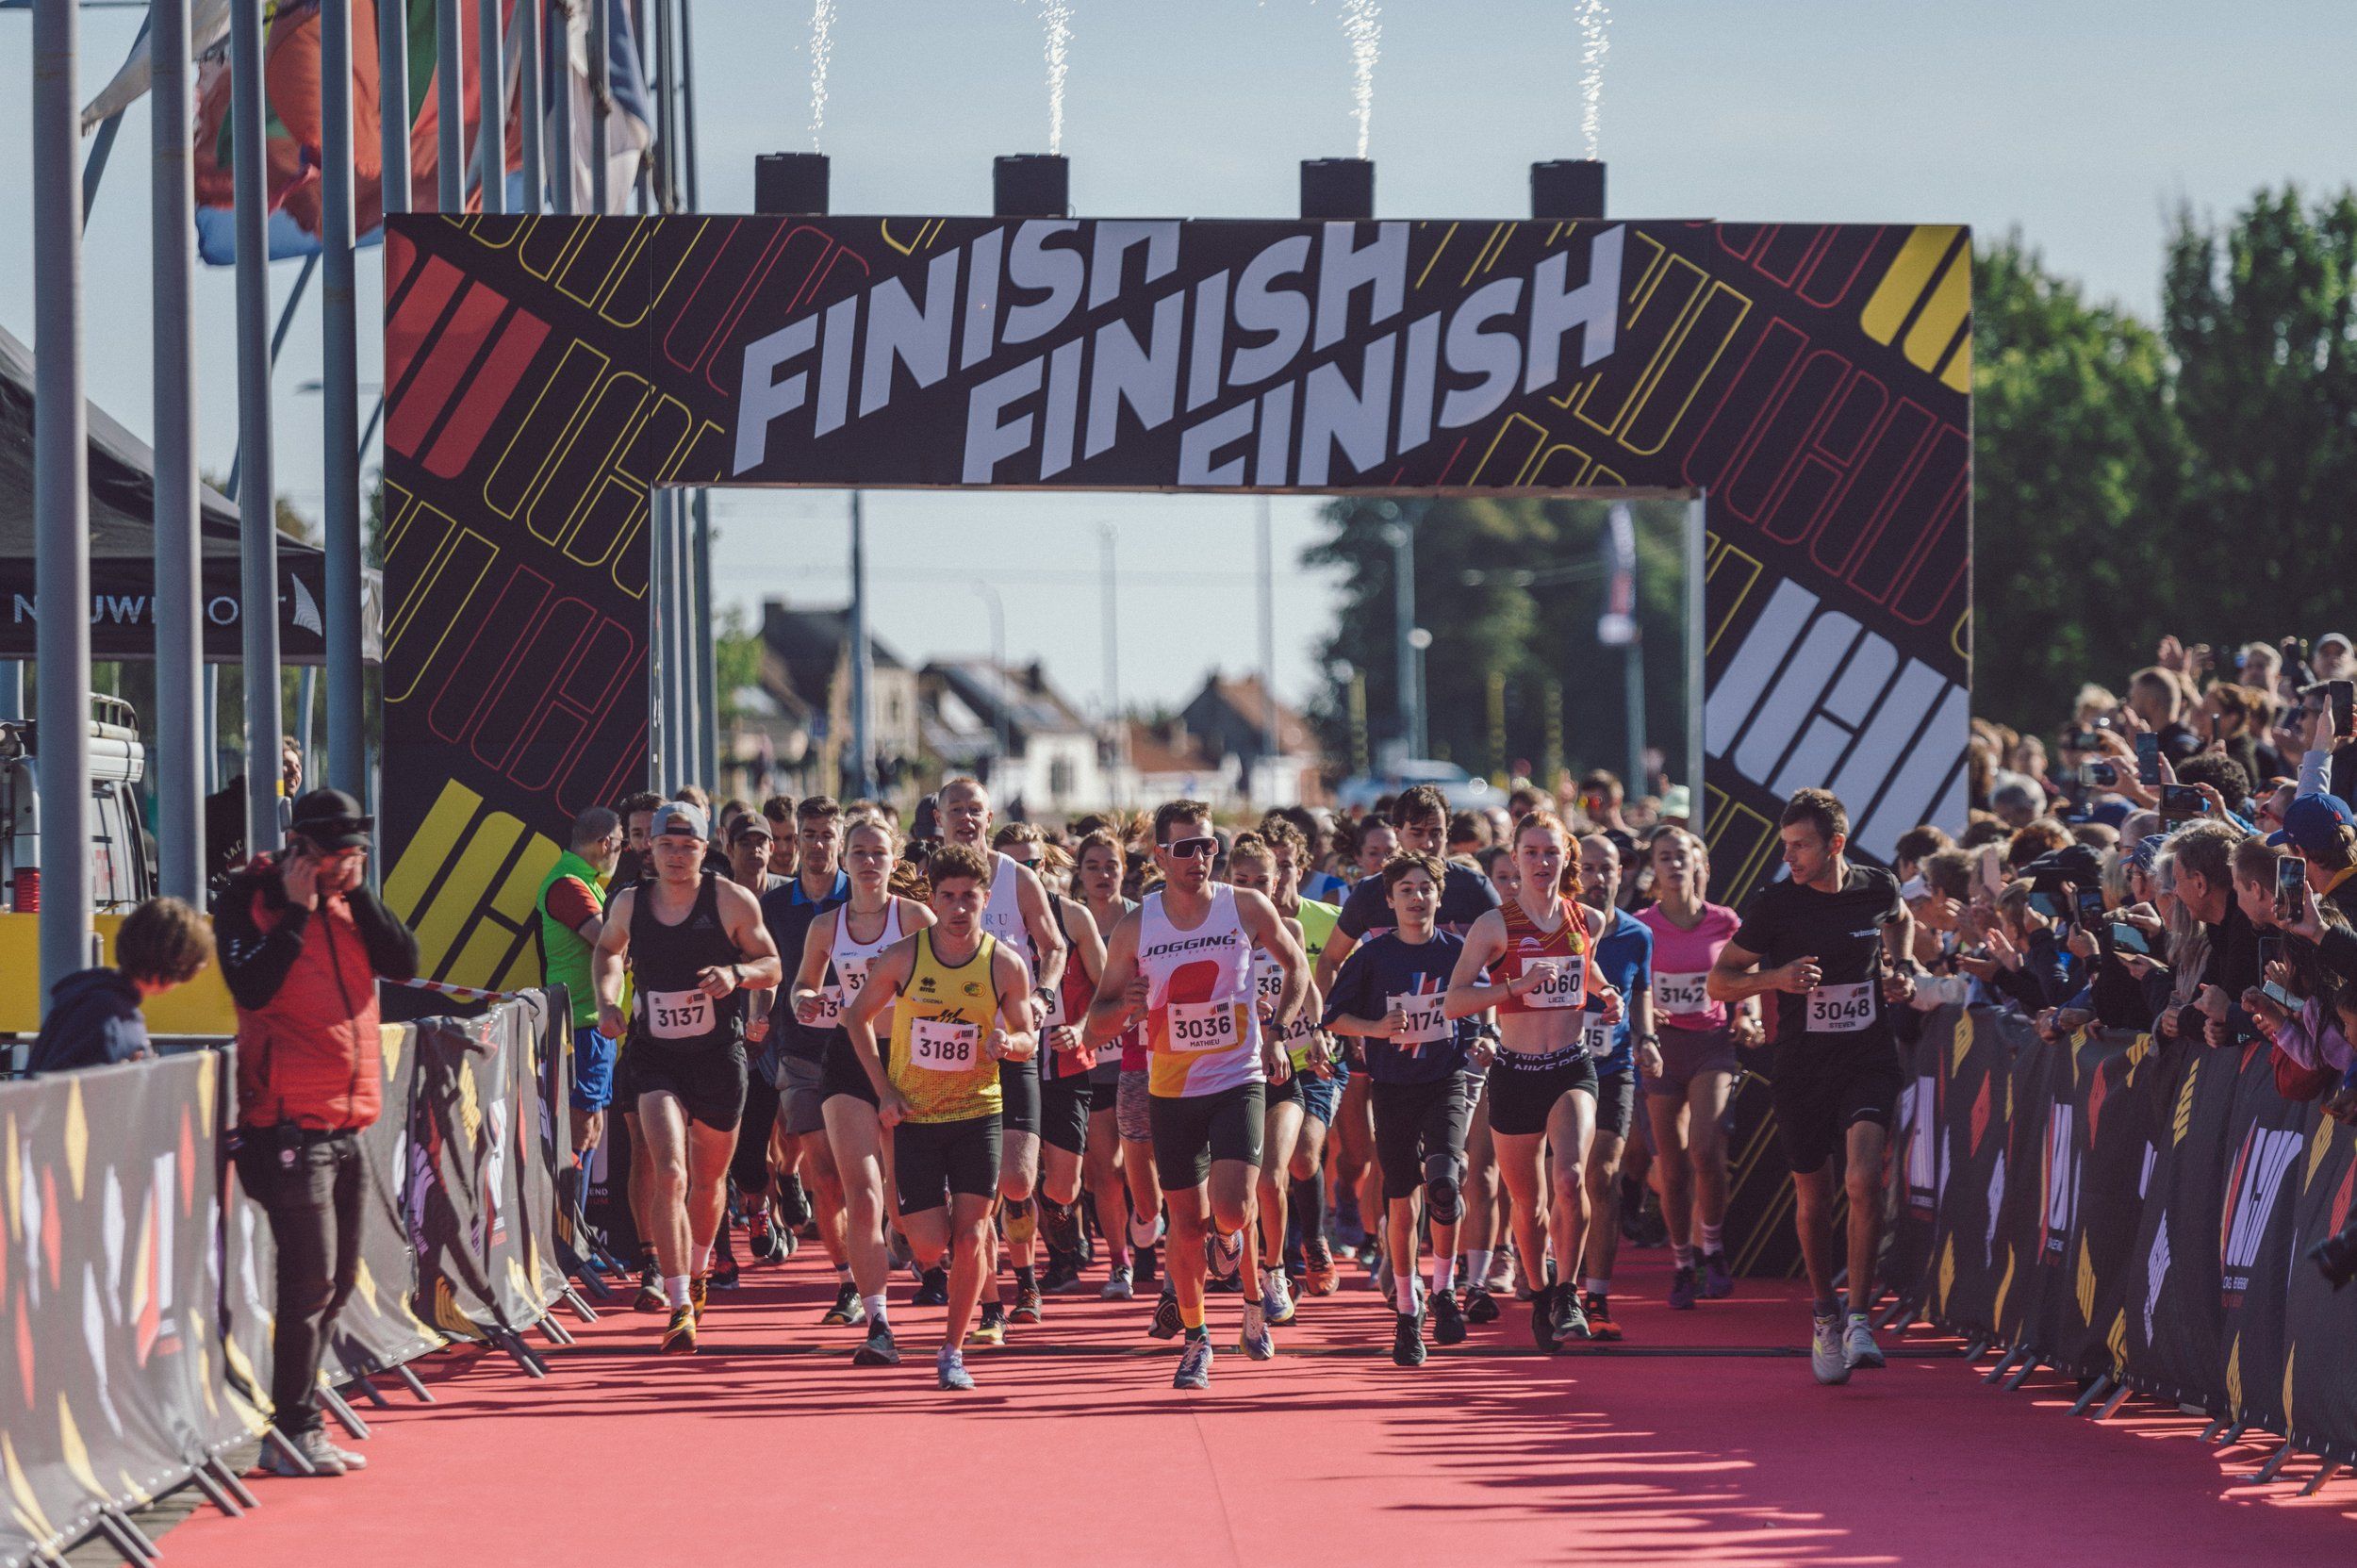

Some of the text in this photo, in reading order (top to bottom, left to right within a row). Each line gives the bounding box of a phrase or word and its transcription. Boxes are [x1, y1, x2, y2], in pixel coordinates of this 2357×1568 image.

[733, 220, 1181, 476] FINISH
[961, 221, 1410, 484] FINISH
[1178, 223, 1626, 486] FINISH
[1142, 935, 1236, 957] JOGGING
[1660, 986, 1705, 1003] 3142
[656, 1005, 705, 1027] 3137
[1813, 999, 1871, 1020] 3048
[1175, 1015, 1231, 1039] 3036
[1405, 1010, 1445, 1032] 174
[919, 1038, 970, 1061] 3188
[1190, 1038, 1220, 1048] MATHIEU
